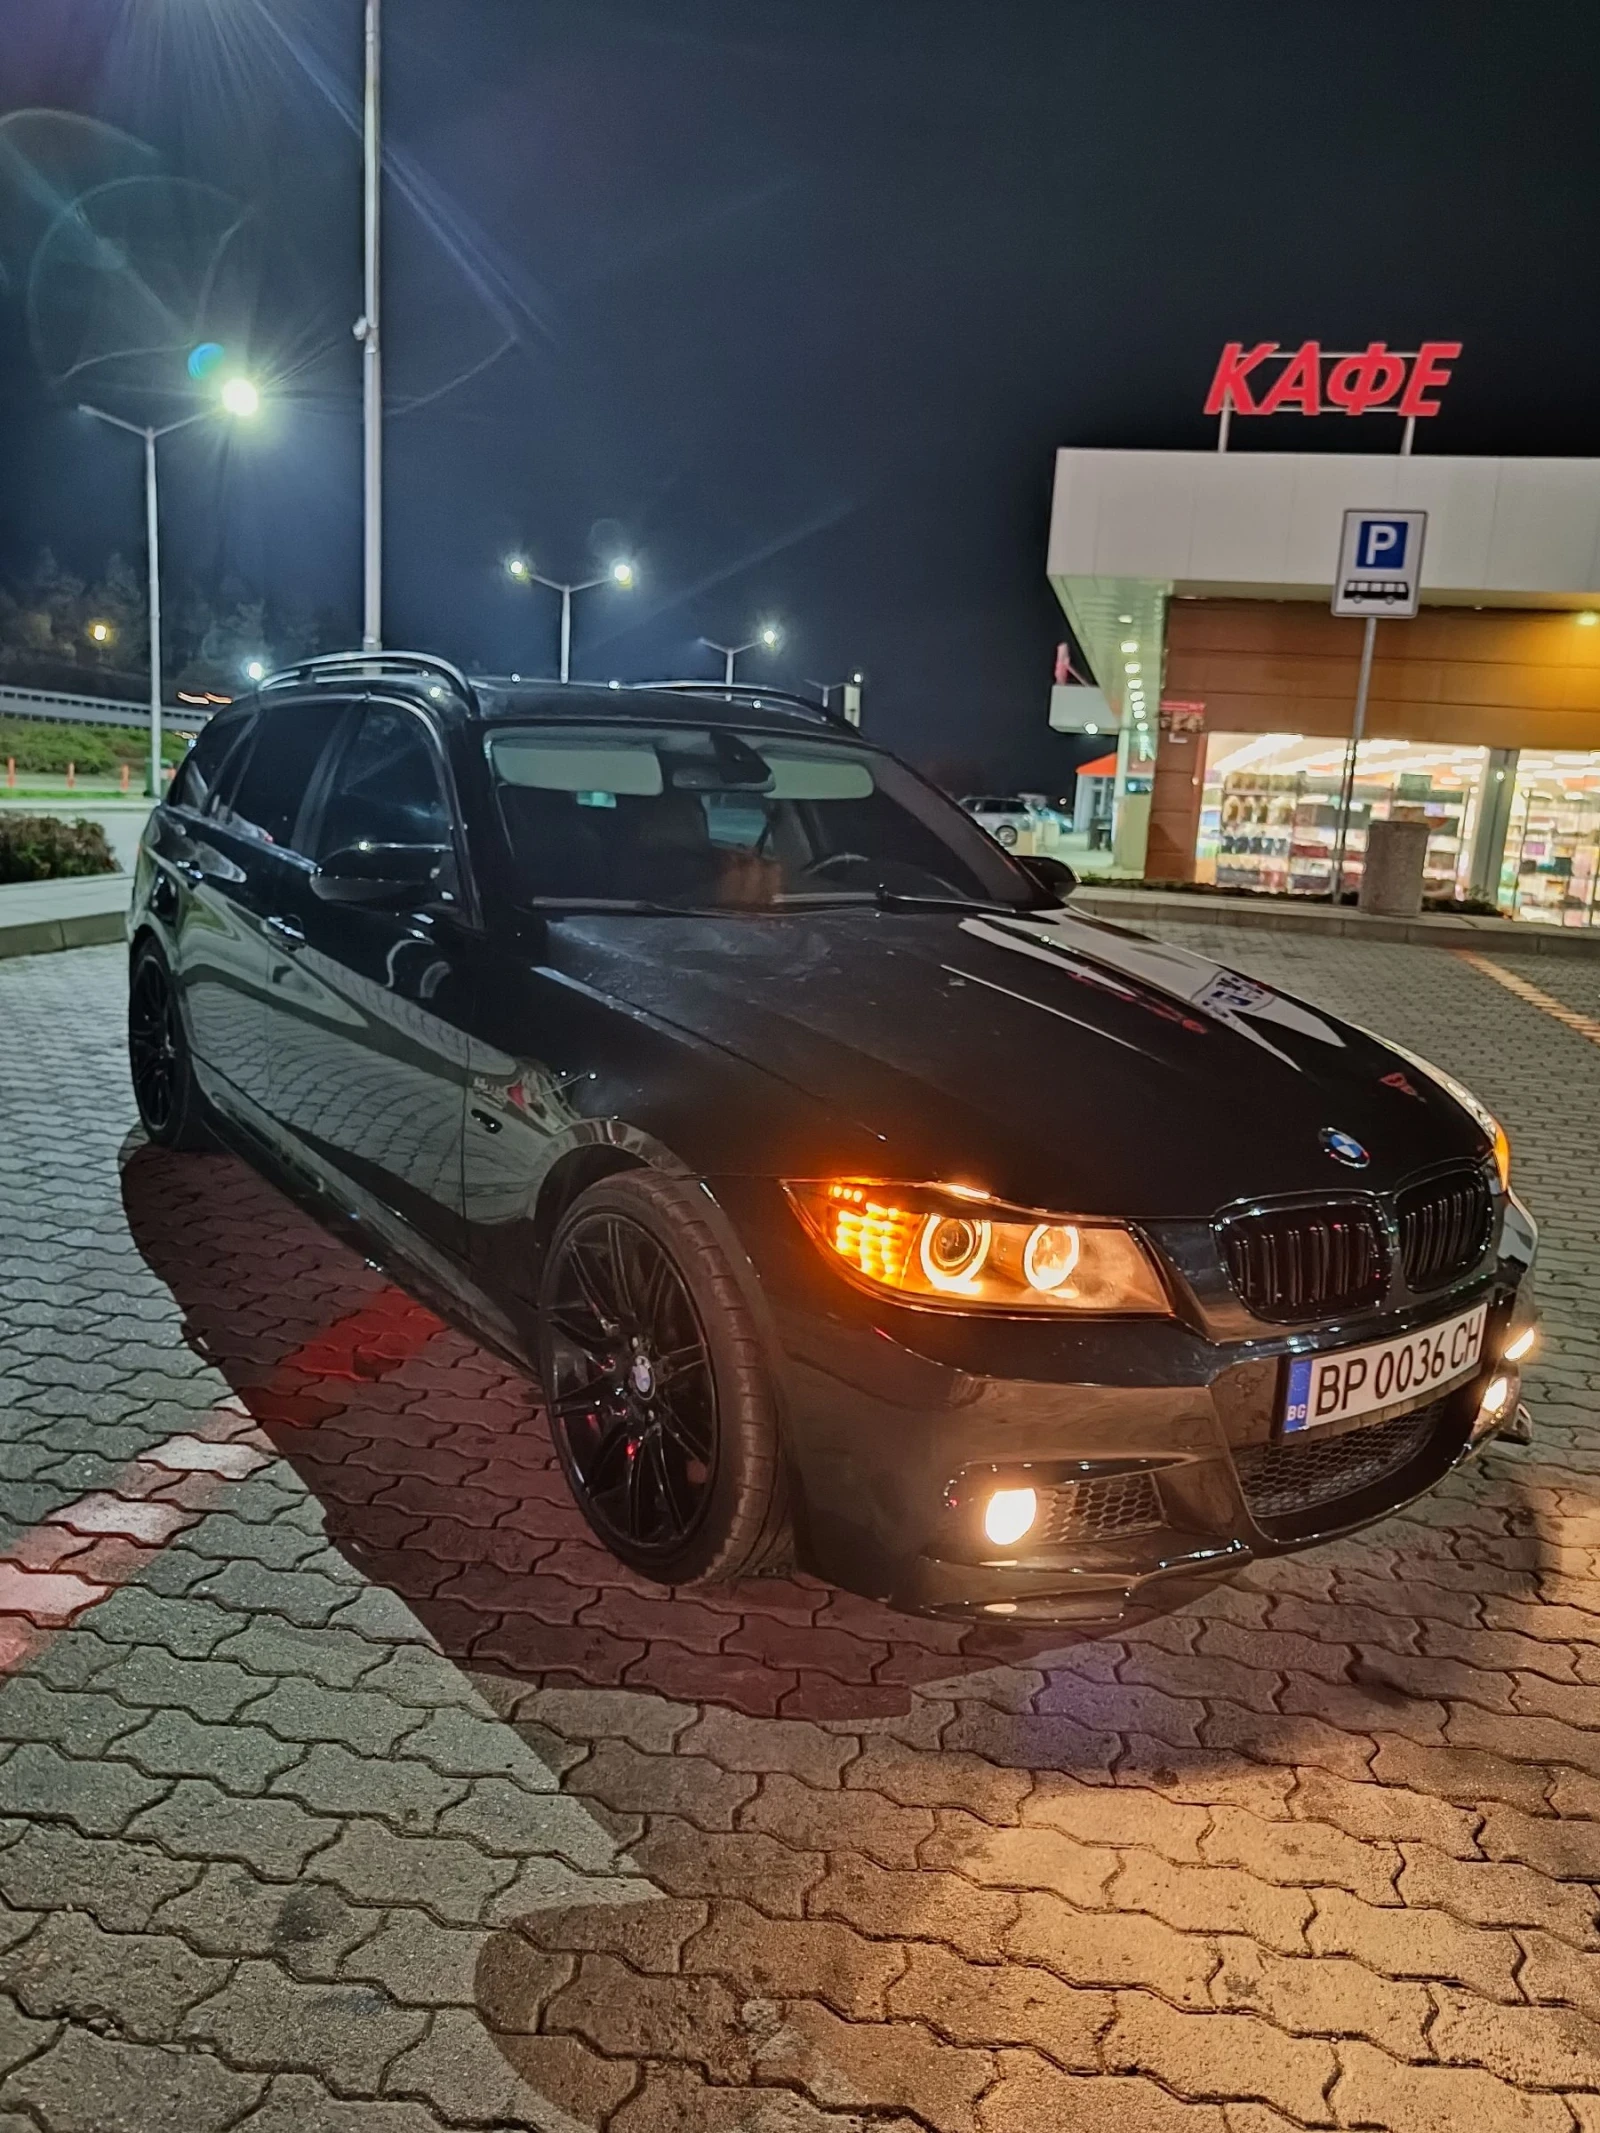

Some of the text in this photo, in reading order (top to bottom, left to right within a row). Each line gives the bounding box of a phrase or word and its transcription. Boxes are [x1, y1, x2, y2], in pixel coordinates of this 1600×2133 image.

[1203, 340, 1463, 417] КАФЕ
[1366, 525, 1397, 565] P
[1315, 1312, 1482, 1416] BP 0036 CH
[1287, 1404, 1306, 1421] BG
